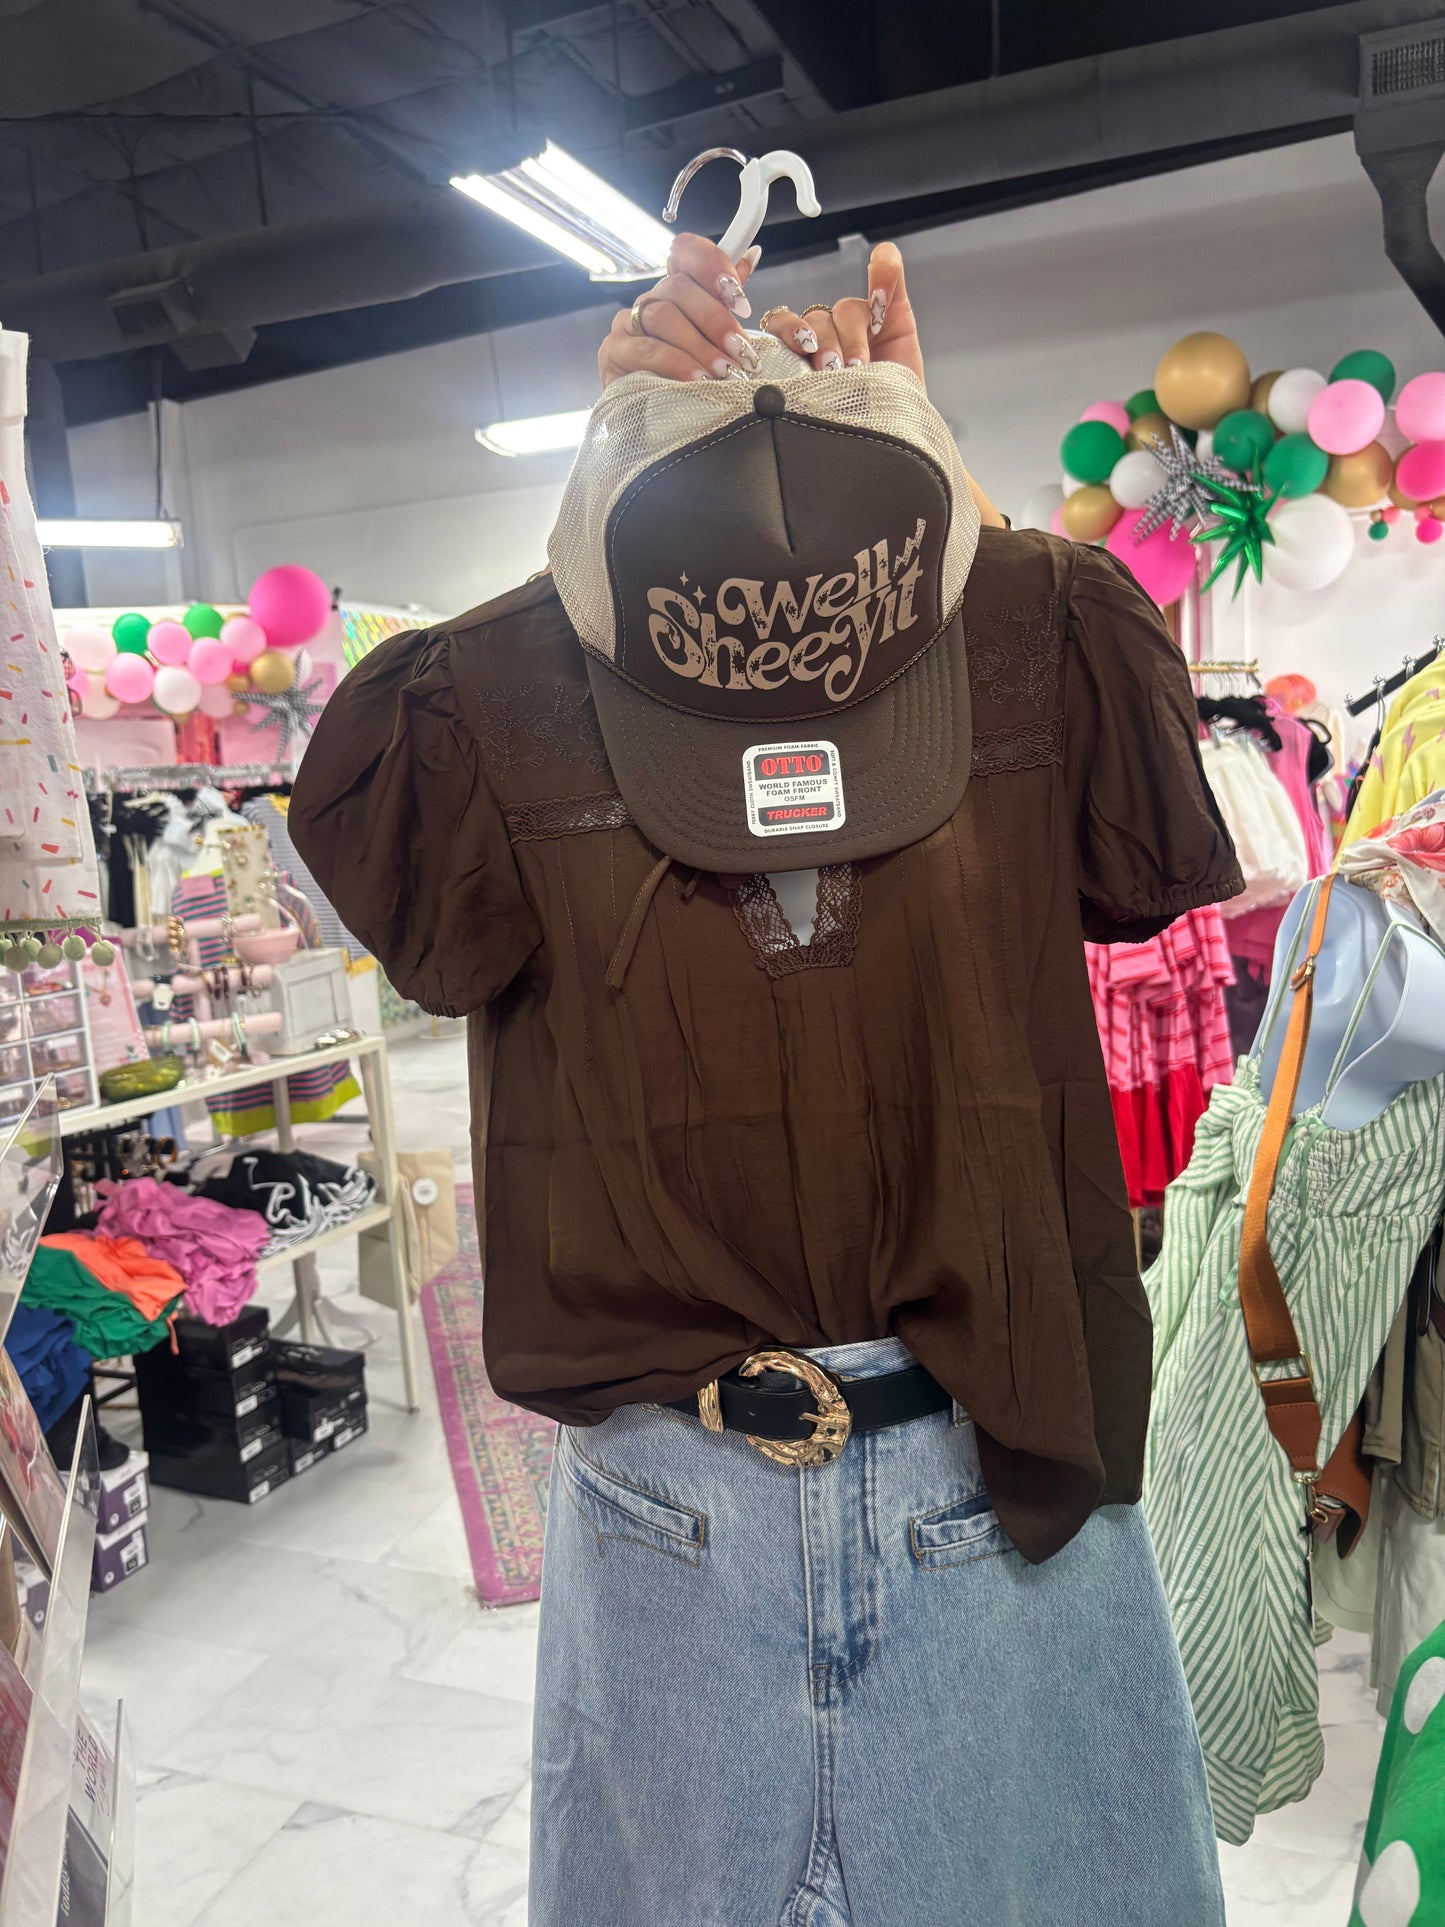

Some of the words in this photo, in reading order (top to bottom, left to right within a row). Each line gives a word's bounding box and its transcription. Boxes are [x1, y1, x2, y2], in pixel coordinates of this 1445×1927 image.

[716, 538, 893, 640] Well
[761, 755, 822, 777] OTTO
[759, 782, 790, 790] WORLD
[792, 779, 828, 787] FAMOUS
[767, 806, 827, 821] TRUCKER
[75, 1729, 88, 1769] THE
[85, 1734, 98, 1803] WORLD
